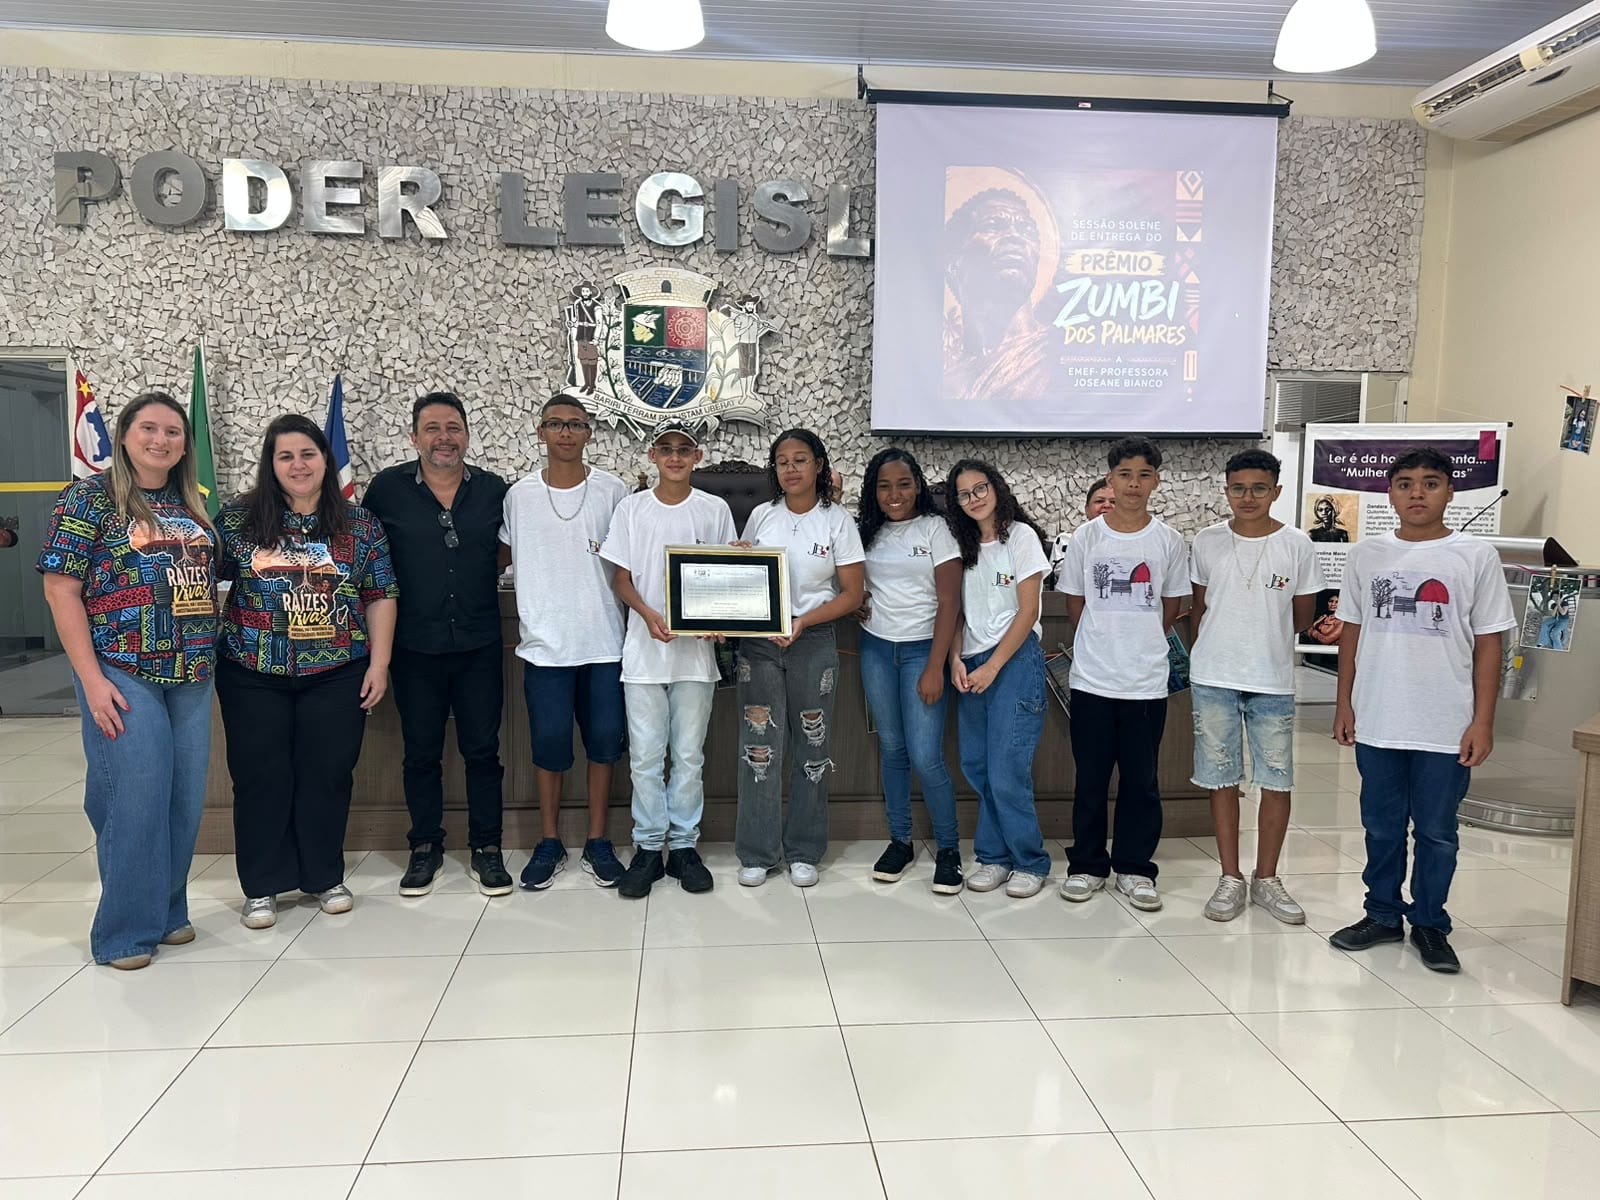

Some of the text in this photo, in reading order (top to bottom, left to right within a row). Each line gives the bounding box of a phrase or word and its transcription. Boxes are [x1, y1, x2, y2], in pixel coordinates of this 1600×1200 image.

[54, 151, 448, 239] PODER
[1072, 219, 1161, 231] SESSÃO SOLENE
[1071, 232, 1162, 242] DE ENTREGA DO
[1080, 250, 1153, 272] PRÊMIO
[1052, 277, 1180, 328] ZUMBI
[1064, 320, 1186, 346] DOS PALMARES
[1100, 367, 1169, 377] PROFESSORA
[1073, 378, 1163, 388] JOSEANE BIANCO
[593, 393, 622, 411] BARIRI
[623, 405, 657, 420] TERRAM
[1328, 454, 1347, 464] Ler
[1350, 453, 1357, 464] é
[1361, 454, 1377, 464] da
[166, 563, 208, 586] RAÍZES
[173, 583, 211, 604] Vivas
[282, 589, 328, 611] RAÍZES
[288, 608, 329, 627] Vivas
